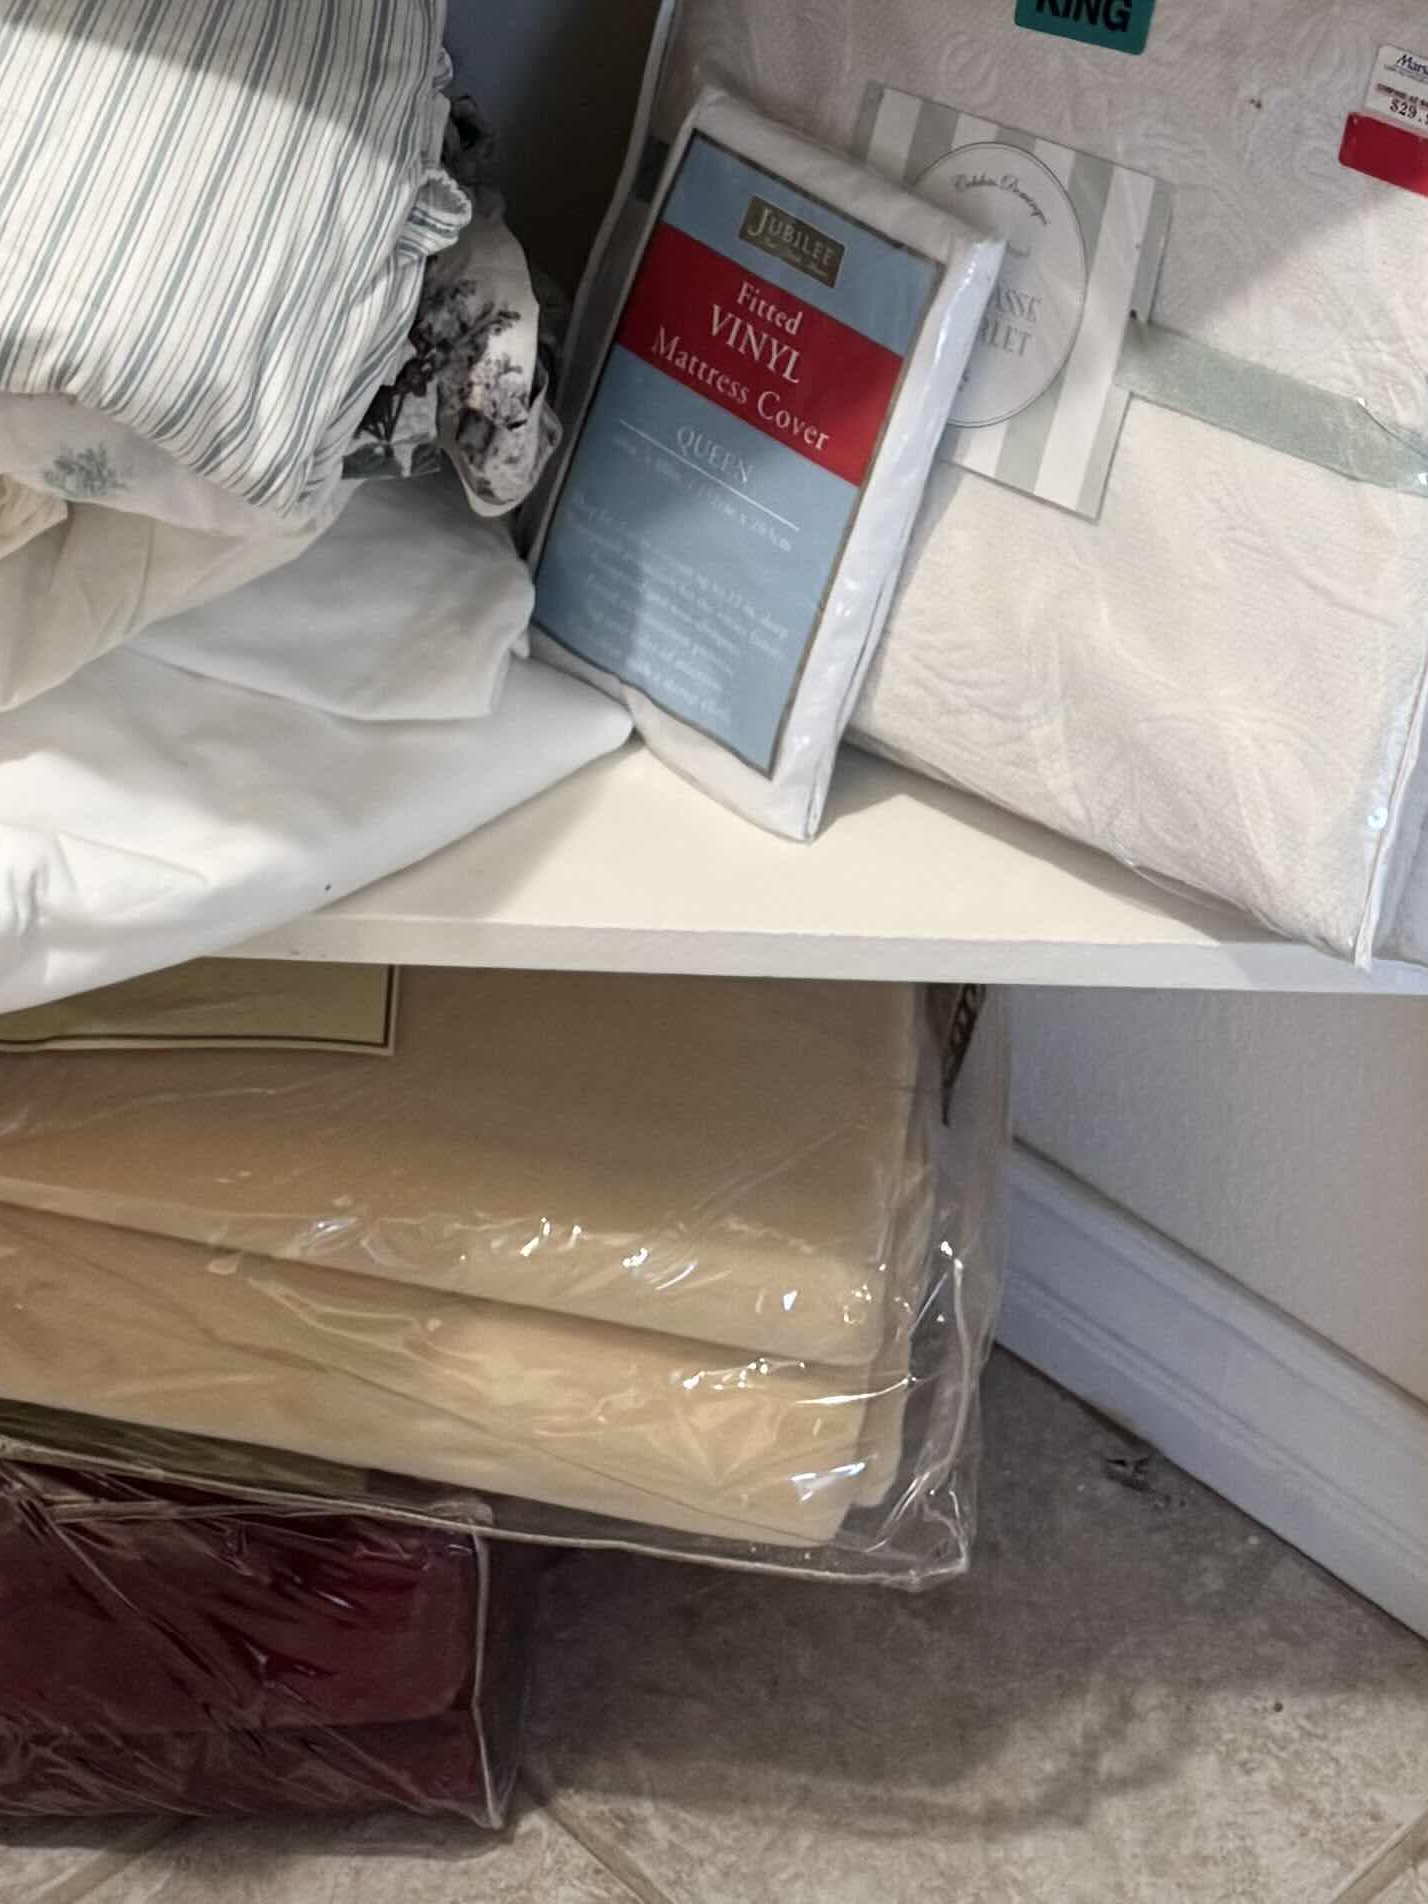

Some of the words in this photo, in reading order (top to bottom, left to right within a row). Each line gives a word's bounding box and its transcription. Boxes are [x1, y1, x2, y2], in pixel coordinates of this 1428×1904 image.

[747, 205, 837, 266] JUBILEE
[736, 279, 804, 337] Fitted
[710, 304, 801, 385] VINYL
[650, 326, 750, 407] Mattress
[756, 390, 830, 454] Cover
[675, 424, 758, 484] QUEEN
